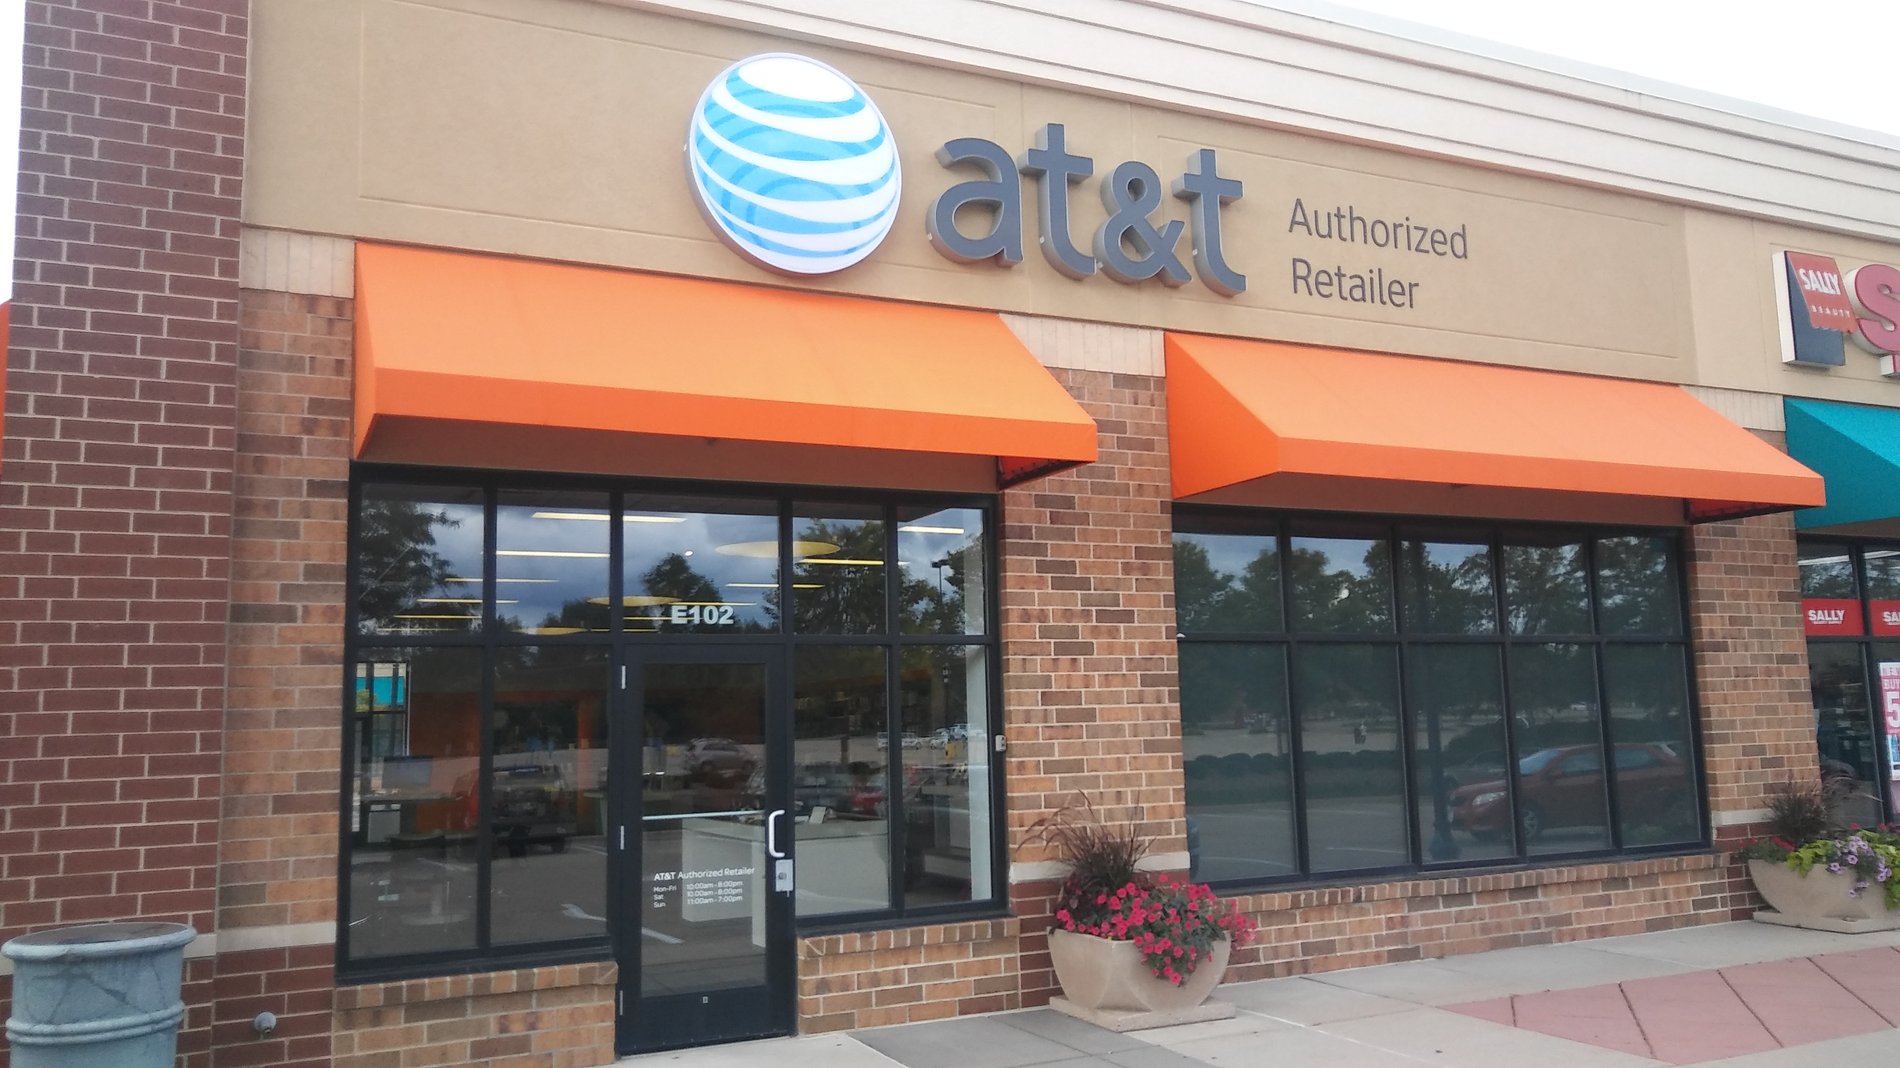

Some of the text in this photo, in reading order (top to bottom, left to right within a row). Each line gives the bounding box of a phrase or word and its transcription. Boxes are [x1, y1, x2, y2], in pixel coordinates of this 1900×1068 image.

[927, 122, 1247, 297] at&t
[1288, 197, 1468, 260] Authorized
[1292, 257, 1420, 309] Retailer
[1798, 267, 1842, 296] SALLY
[671, 605, 734, 625] E102
[1808, 609, 1846, 621] SALLY
[1882, 611, 1900, 623] SA
[654, 867, 755, 881] AT&T Authorized Retailer
[653, 885, 677, 893] Mon-Fri
